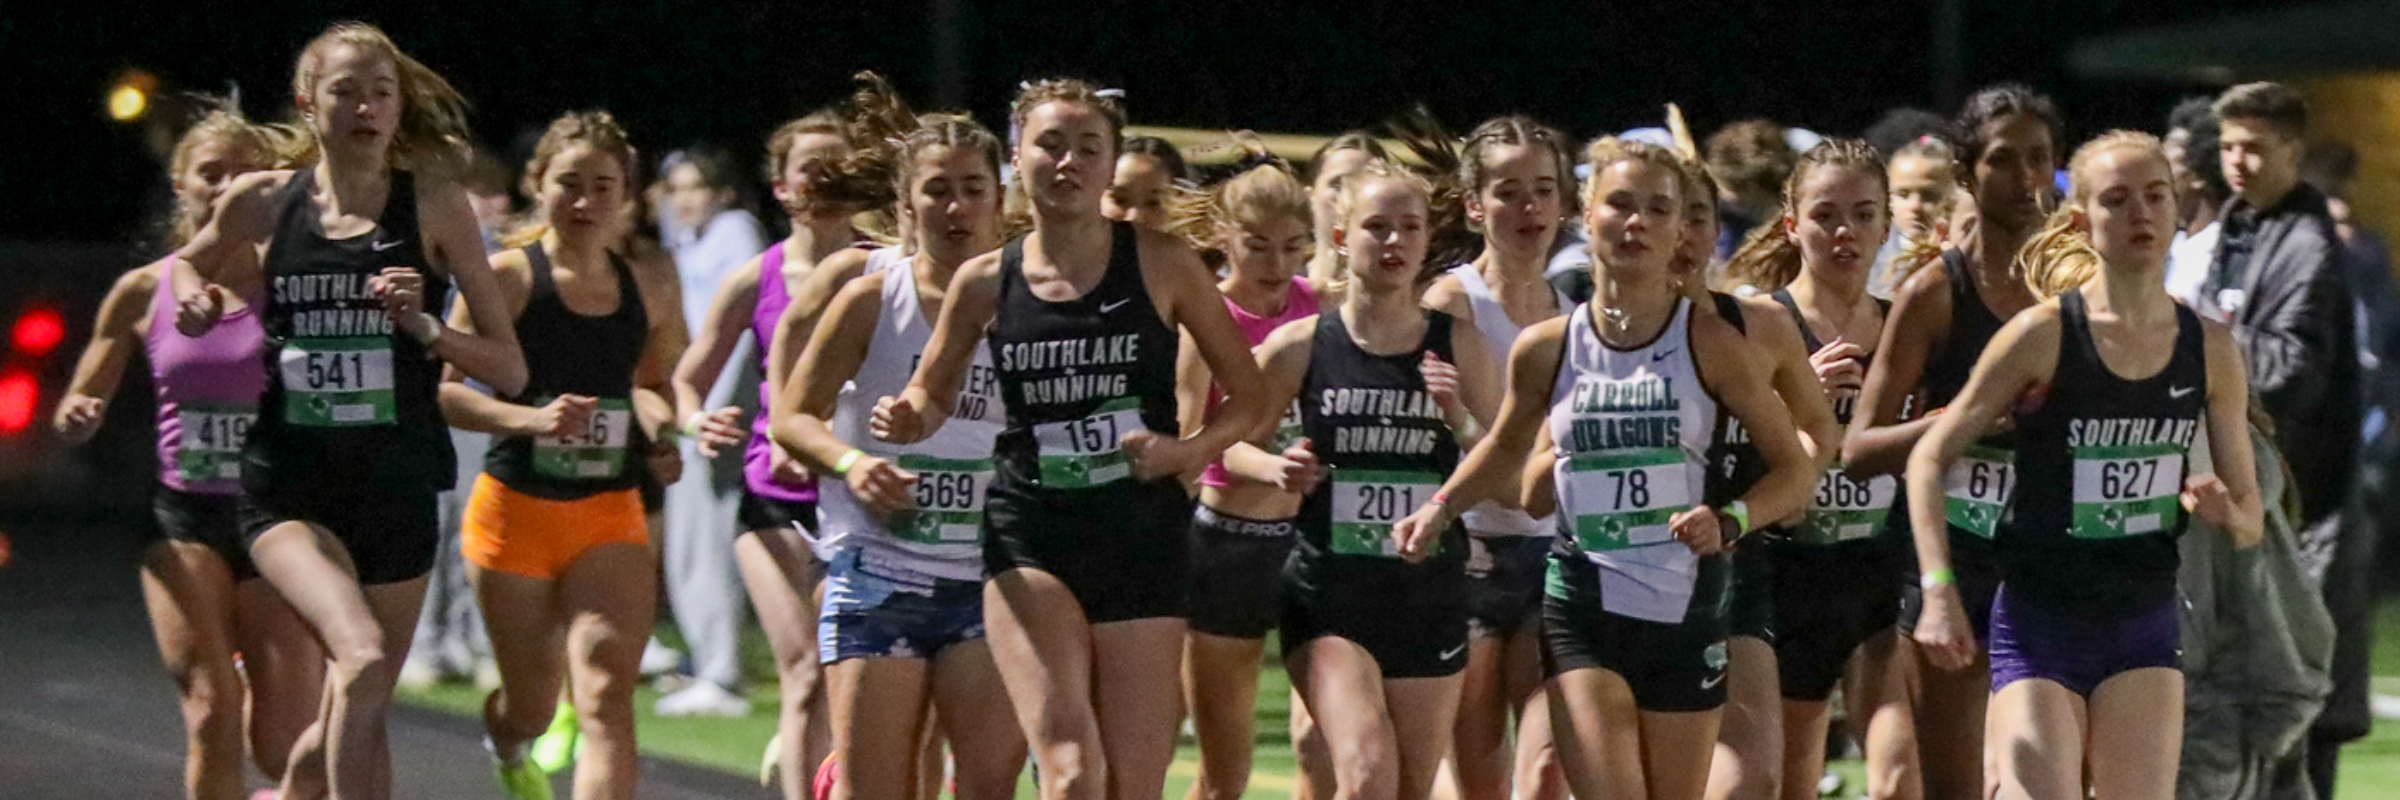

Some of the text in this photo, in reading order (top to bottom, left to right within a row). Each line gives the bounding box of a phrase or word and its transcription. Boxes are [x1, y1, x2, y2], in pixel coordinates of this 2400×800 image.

[274, 274, 376, 303] SOUTHLA
[294, 310, 393, 336] RUNNING
[307, 352, 363, 389] 541
[1002, 334, 1139, 371] SOUTHLAKE
[1022, 374, 1128, 405] RUNNING
[1572, 377, 1680, 413] CARROLL
[199, 416, 248, 449] 419
[1064, 414, 1117, 453] 157
[1335, 426, 1437, 454] RUNNING
[1571, 416, 1680, 452] DRAGONS
[916, 472, 974, 508] 569
[1607, 469, 1649, 509] 78
[1815, 470, 1871, 508] 368
[2101, 458, 2158, 499] 627
[1358, 485, 1413, 520] 201
[1242, 522, 1292, 536] PRO
